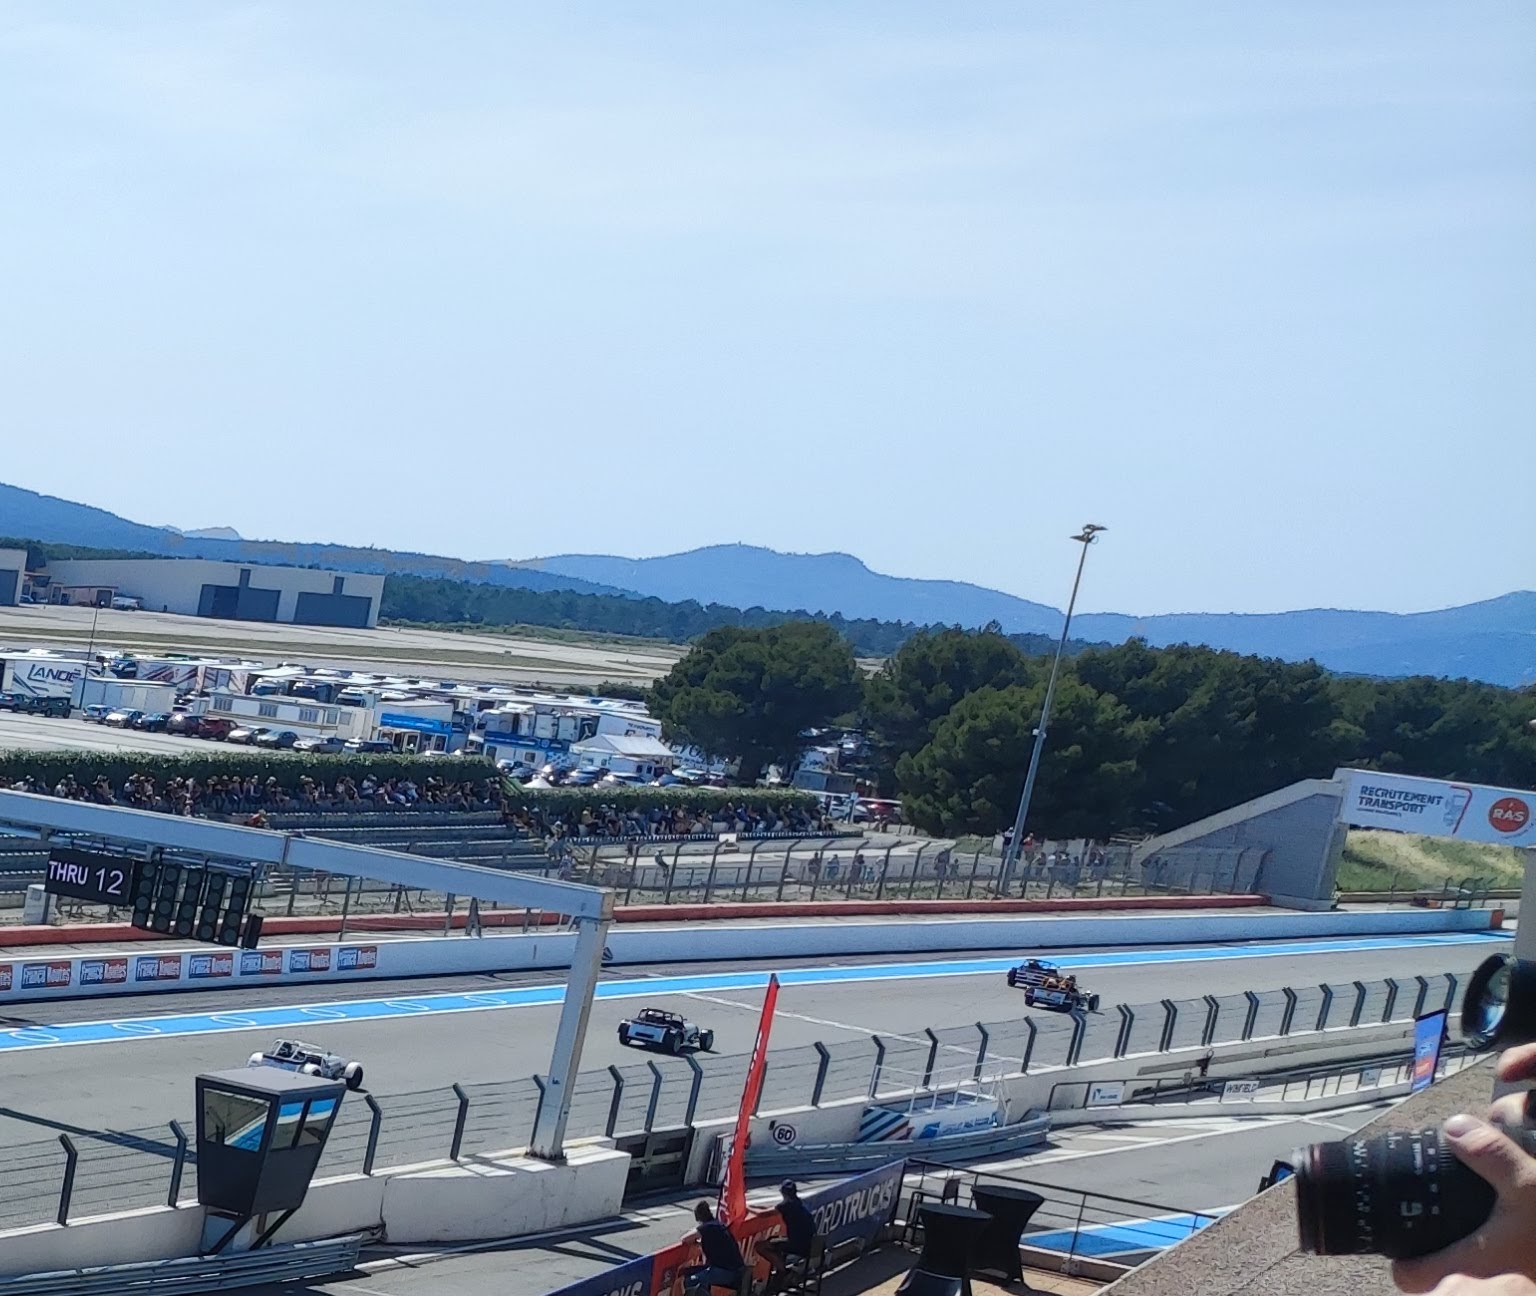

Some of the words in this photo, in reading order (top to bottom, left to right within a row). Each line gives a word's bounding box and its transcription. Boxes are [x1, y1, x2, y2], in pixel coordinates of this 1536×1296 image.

[1358, 796, 1427, 814] TRANSPORT
[48, 860, 89, 886] THRU
[95, 868, 124, 895] 12
[777, 1128, 793, 1141] 60
